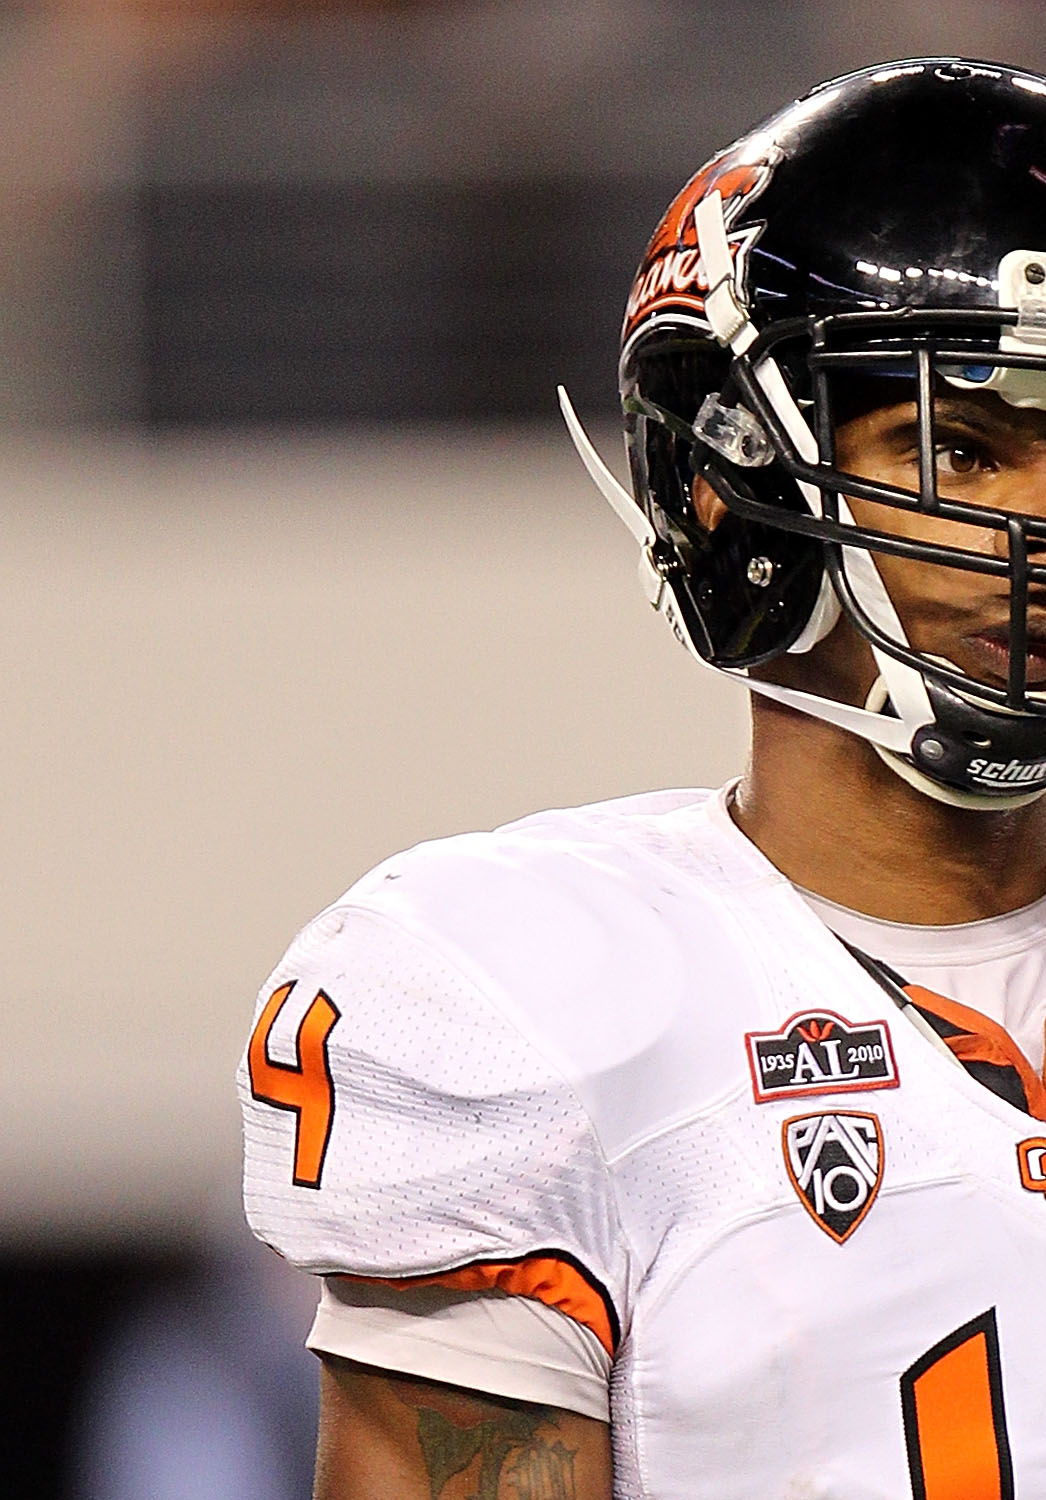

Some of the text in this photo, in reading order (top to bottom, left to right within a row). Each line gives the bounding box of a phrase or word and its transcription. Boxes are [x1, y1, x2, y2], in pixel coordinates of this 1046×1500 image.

[248, 979, 342, 1190] 4
[760, 1039, 883, 1083] 1935 AL 2010
[787, 1115, 879, 1191] PAC
[813, 1165, 868, 1214] 10
